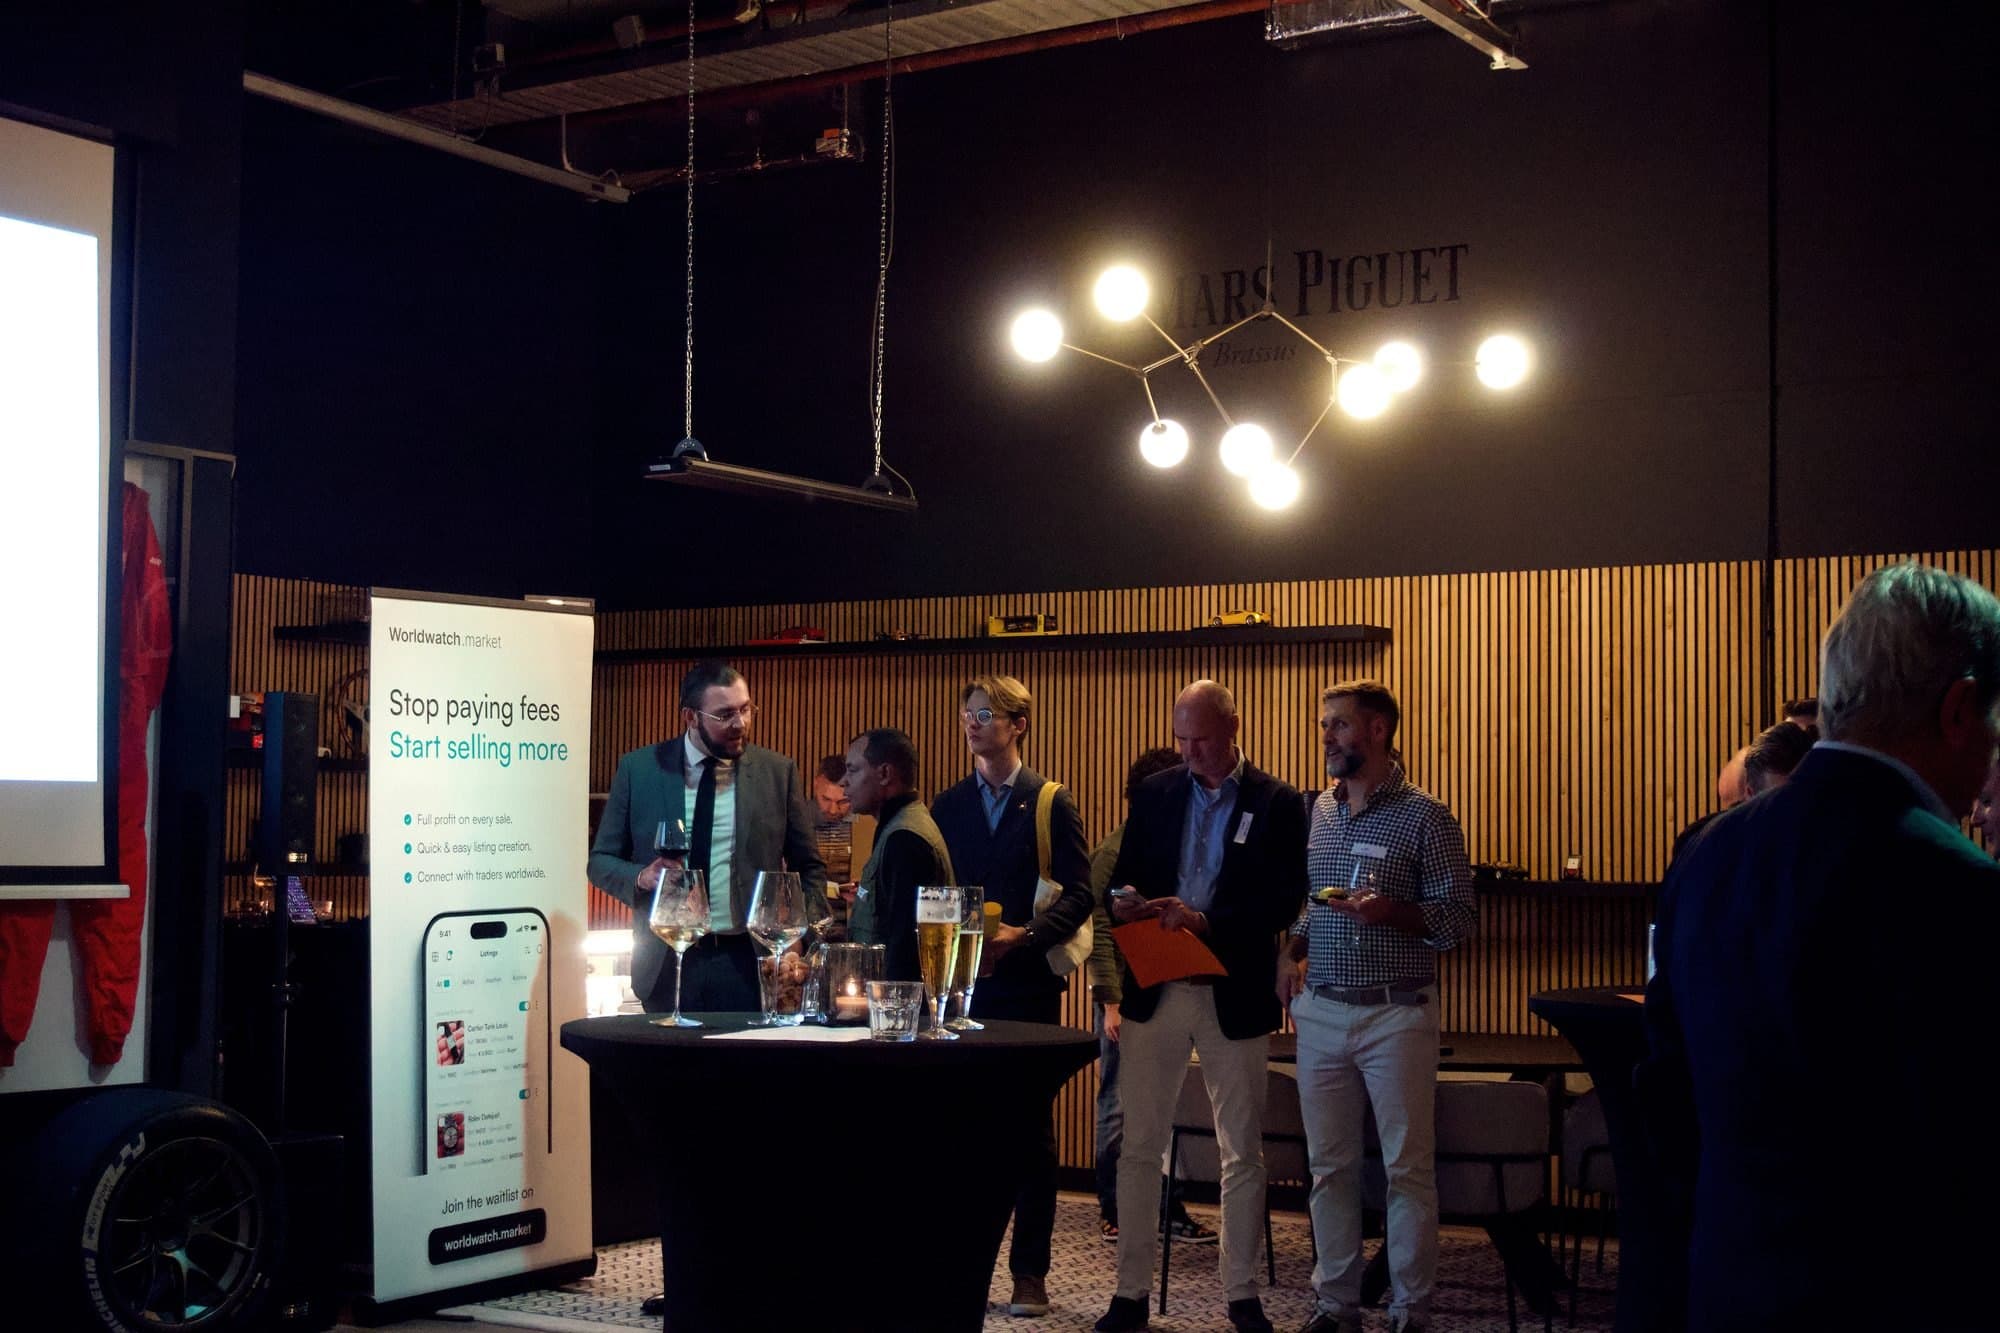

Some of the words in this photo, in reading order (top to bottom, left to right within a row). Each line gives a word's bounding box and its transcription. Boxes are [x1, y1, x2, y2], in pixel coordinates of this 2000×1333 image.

[1293, 244, 1468, 318] PIGUET
[389, 626, 502, 649] Worldwatch.market
[390, 689, 439, 725] Stop
[446, 693, 513, 727] paying
[520, 695, 560, 722] fees
[390, 731, 441, 759] Start
[447, 733, 512, 767] selling
[519, 742, 568, 761] more
[417, 813, 432, 825] Full
[434, 813, 456, 827] profit
[458, 815, 470, 825] on
[472, 815, 493, 827] every
[495, 813, 513, 825] sale.
[417, 842, 441, 854] Quick
[443, 842, 450, 853] &
[452, 844, 471, 855] easy
[473, 841, 495, 854] listing
[497, 841, 531, 852] creation.
[417, 871, 453, 883] Connect
[456, 870, 474, 881] with
[476, 869, 503, 880] traders
[505, 867, 546, 879] worldwide.
[442, 1197, 464, 1215] Join
[466, 1195, 483, 1209] the
[486, 1189, 519, 1205] waitlist
[521, 1187, 534, 1199] on
[444, 1223, 532, 1251] worldwatch.market
